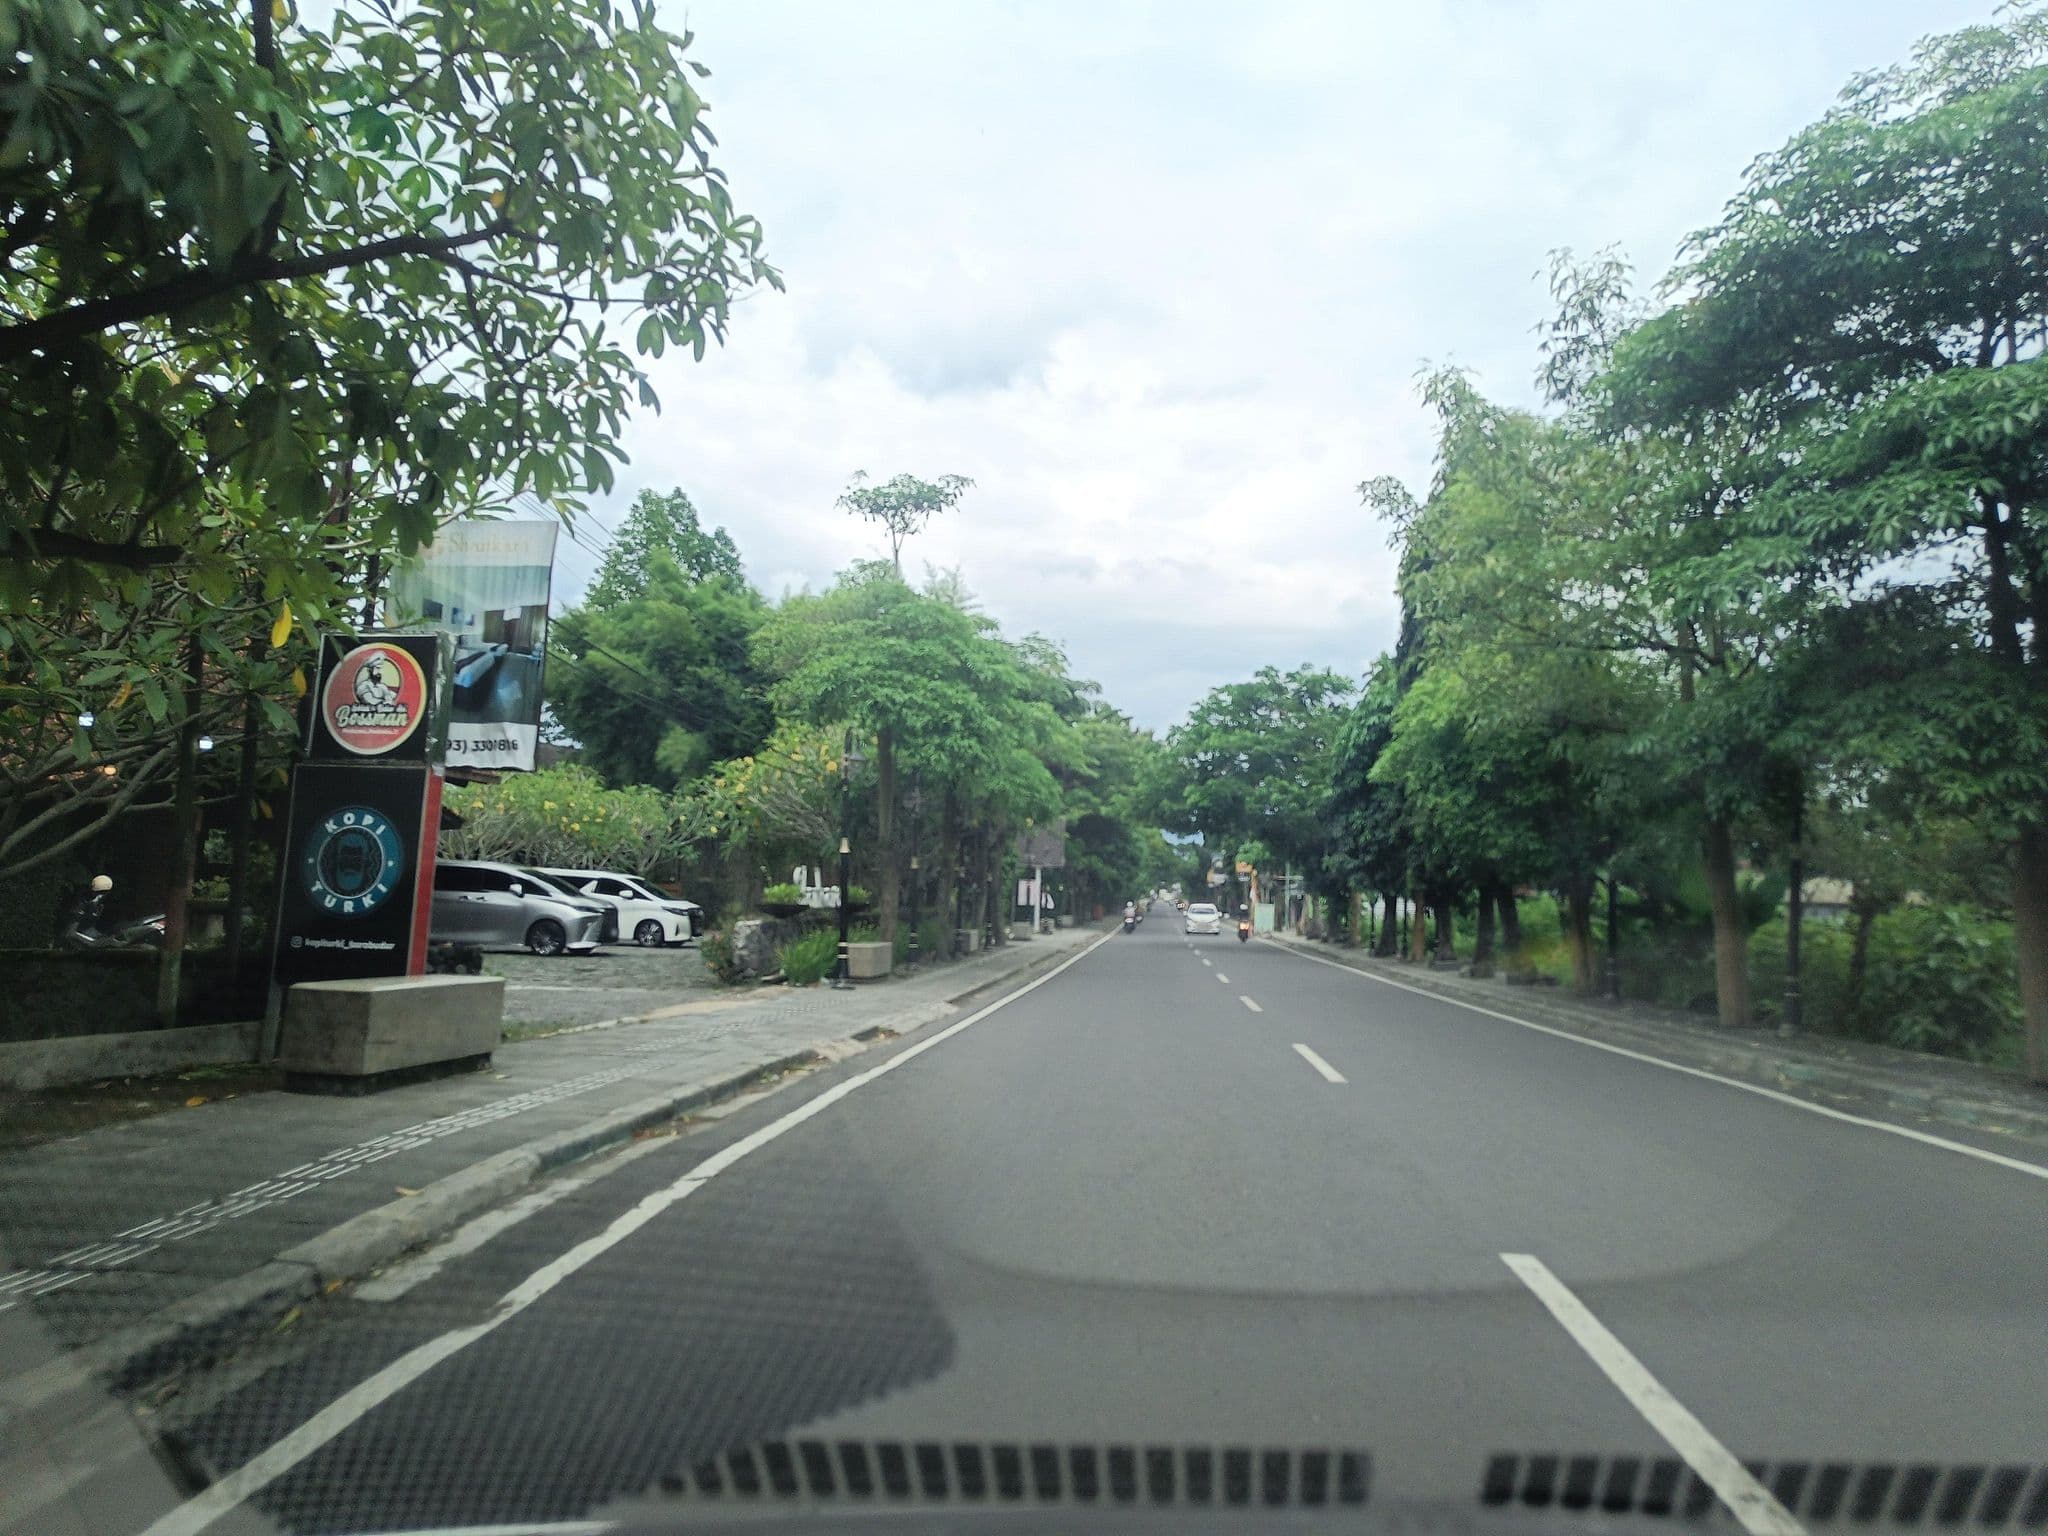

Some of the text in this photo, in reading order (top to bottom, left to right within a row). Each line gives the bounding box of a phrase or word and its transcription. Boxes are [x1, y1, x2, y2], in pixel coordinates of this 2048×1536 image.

[335, 704, 408, 727] Bossman
[324, 812, 386, 835] KOPI
[311, 880, 388, 912] TURKI
